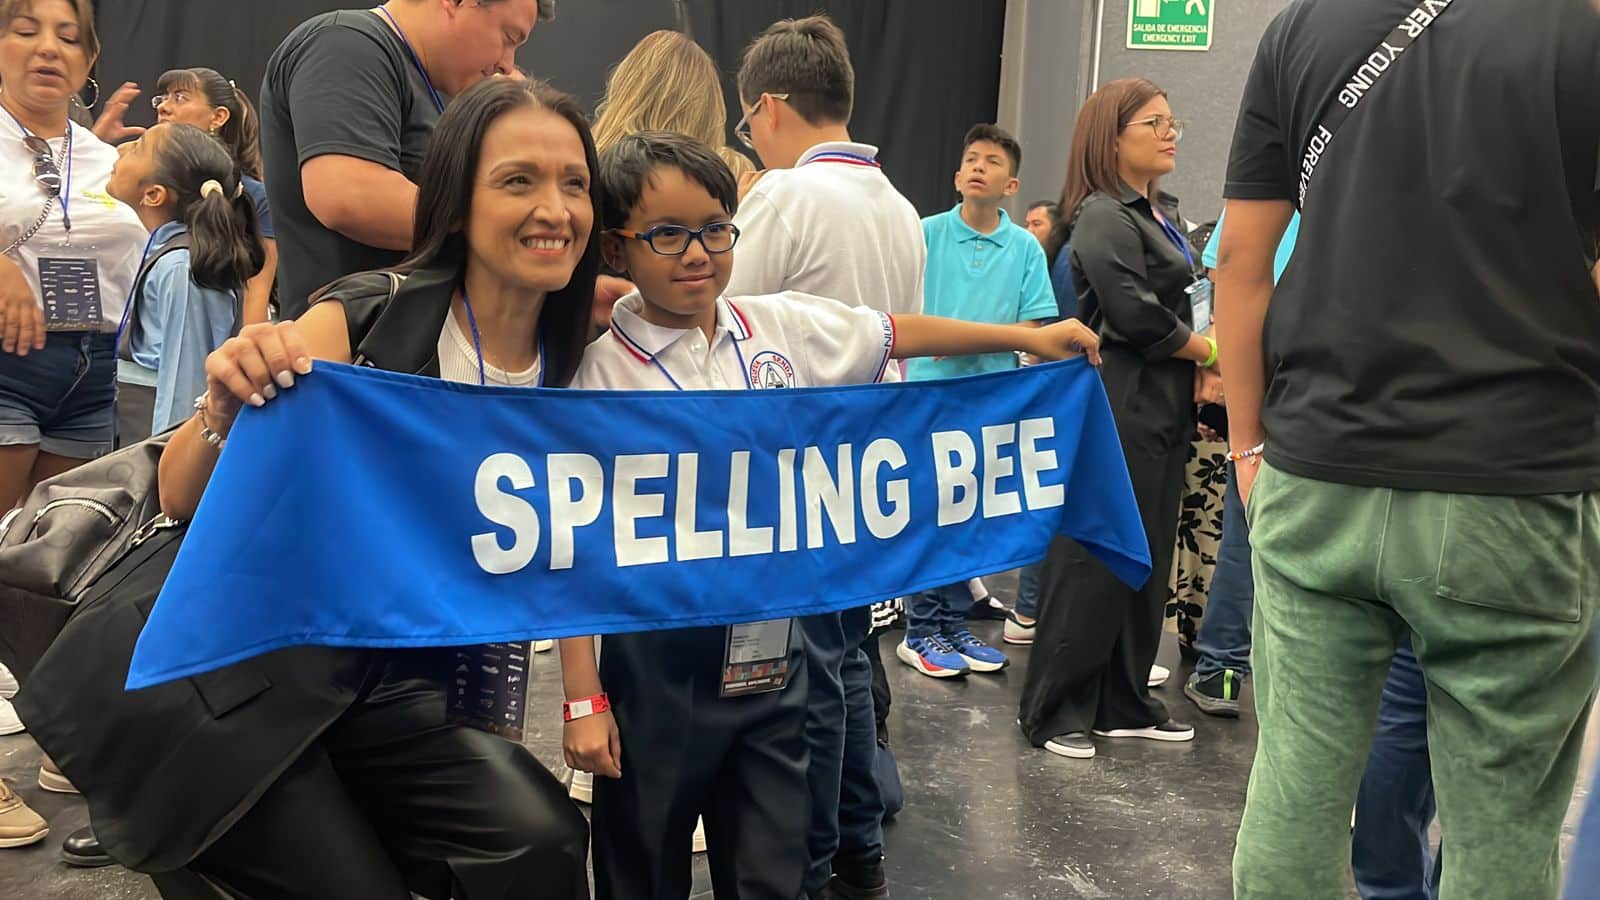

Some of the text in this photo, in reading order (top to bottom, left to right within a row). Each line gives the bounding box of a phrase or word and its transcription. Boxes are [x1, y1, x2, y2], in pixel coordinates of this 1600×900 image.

[1133, 23, 1208, 33] SALIDA DE EMERGENCIA
[1143, 33, 1197, 43] EMERGENCY EXIT
[1338, 41, 1404, 108] YOUNG
[772, 355, 793, 378] SENDA
[471, 416, 1065, 575] SPELLING BEE
